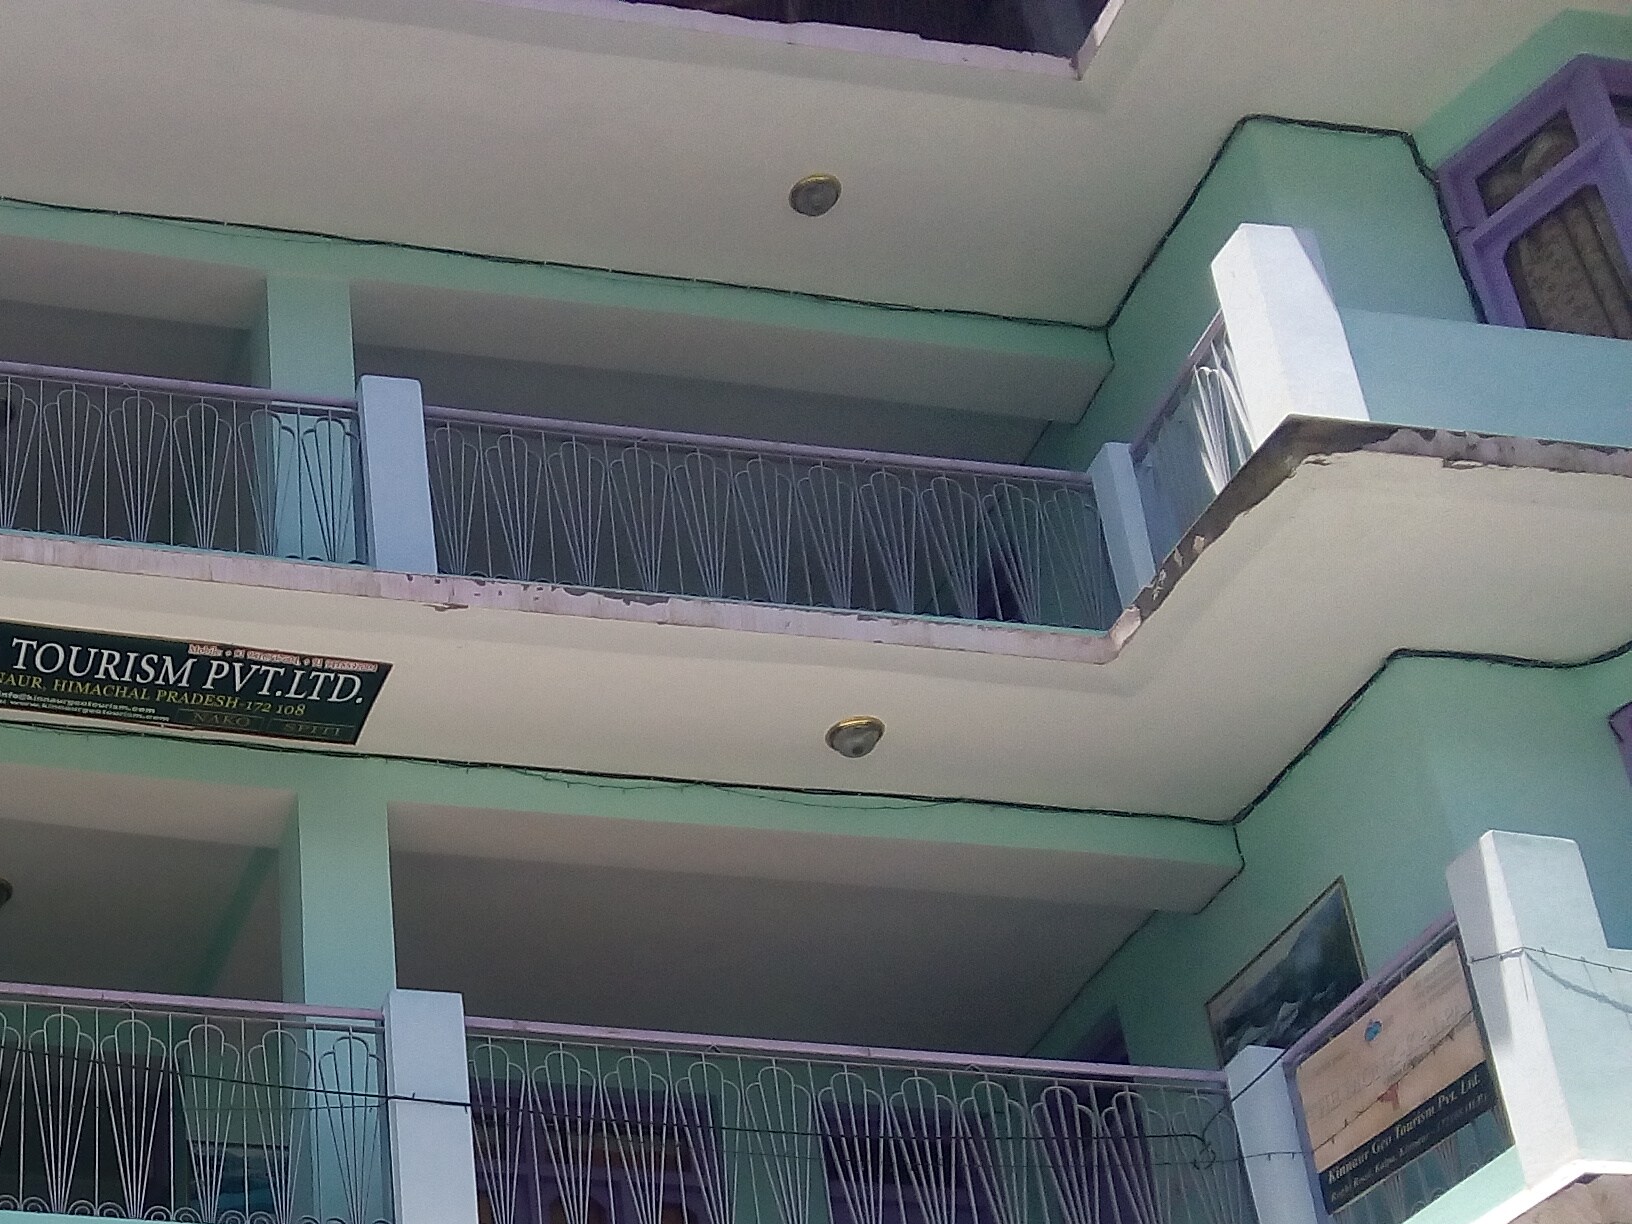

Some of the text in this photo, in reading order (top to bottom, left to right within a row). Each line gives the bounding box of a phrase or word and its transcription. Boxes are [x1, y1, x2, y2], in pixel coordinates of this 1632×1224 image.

[11, 637, 197, 687] TOURISM
[52, 678, 150, 701] HIMACHAL
[276, 703, 306, 717] 108
[192, 710, 251, 727] NAKO
